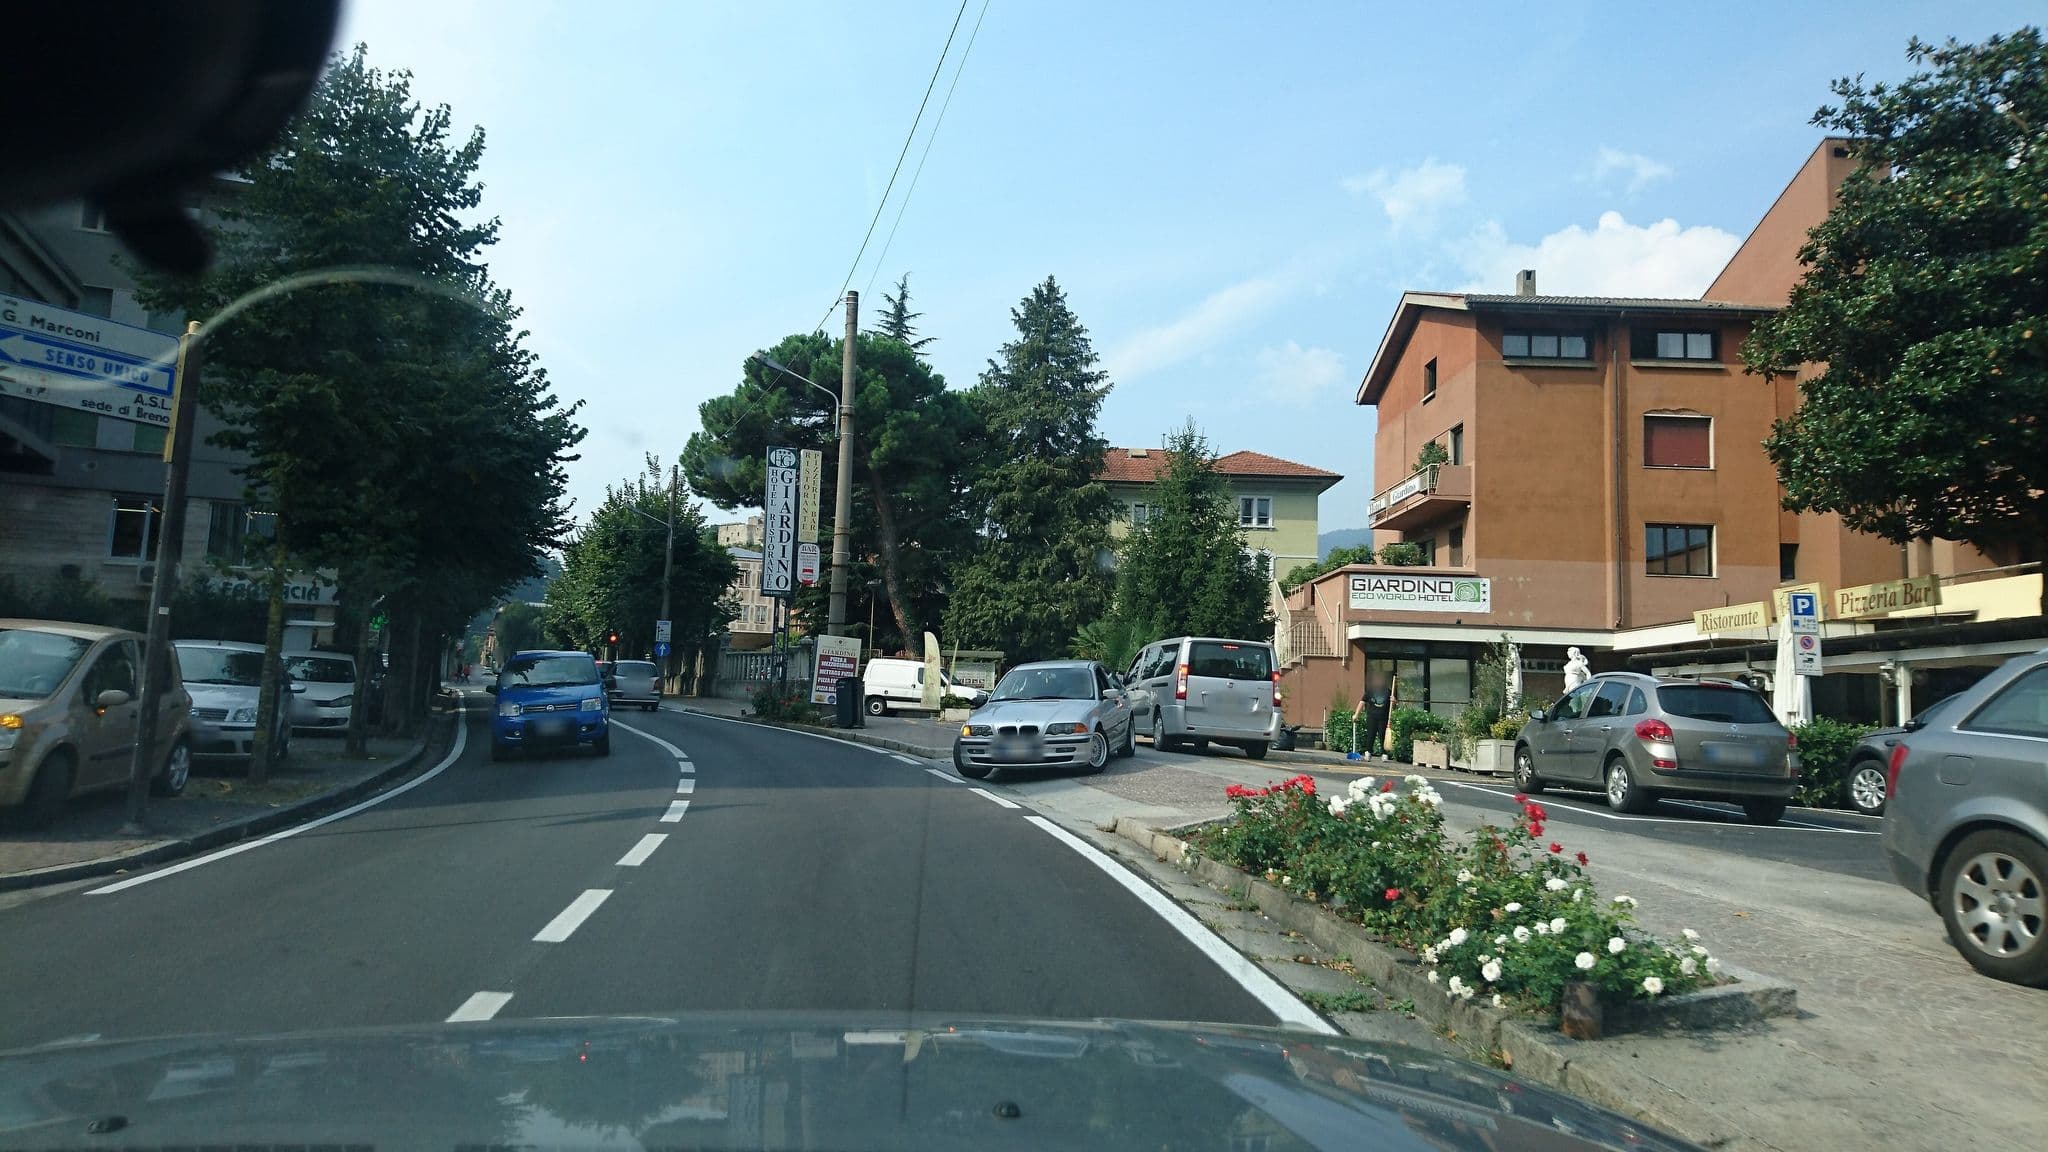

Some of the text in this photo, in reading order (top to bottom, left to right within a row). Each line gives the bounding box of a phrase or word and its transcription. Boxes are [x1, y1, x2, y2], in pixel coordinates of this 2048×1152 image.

[3, 308, 100, 343] G. Marconi
[46, 348, 149, 382] SENSO UNICO
[81, 398, 170, 425] sede di Breno
[134, 393, 172, 411] A.S.L.
[770, 469, 778, 507] HOTEL
[775, 470, 794, 590] GIARDINO
[766, 513, 776, 589] RISTORANTE
[1352, 578, 1454, 594] GIARDINO
[1352, 592, 1454, 602] ECO WORLD HOTEL
[1840, 583, 1932, 615] Pizzeria Bar
[1796, 598, 1810, 614] P
[1701, 611, 1759, 632] Ristorante
